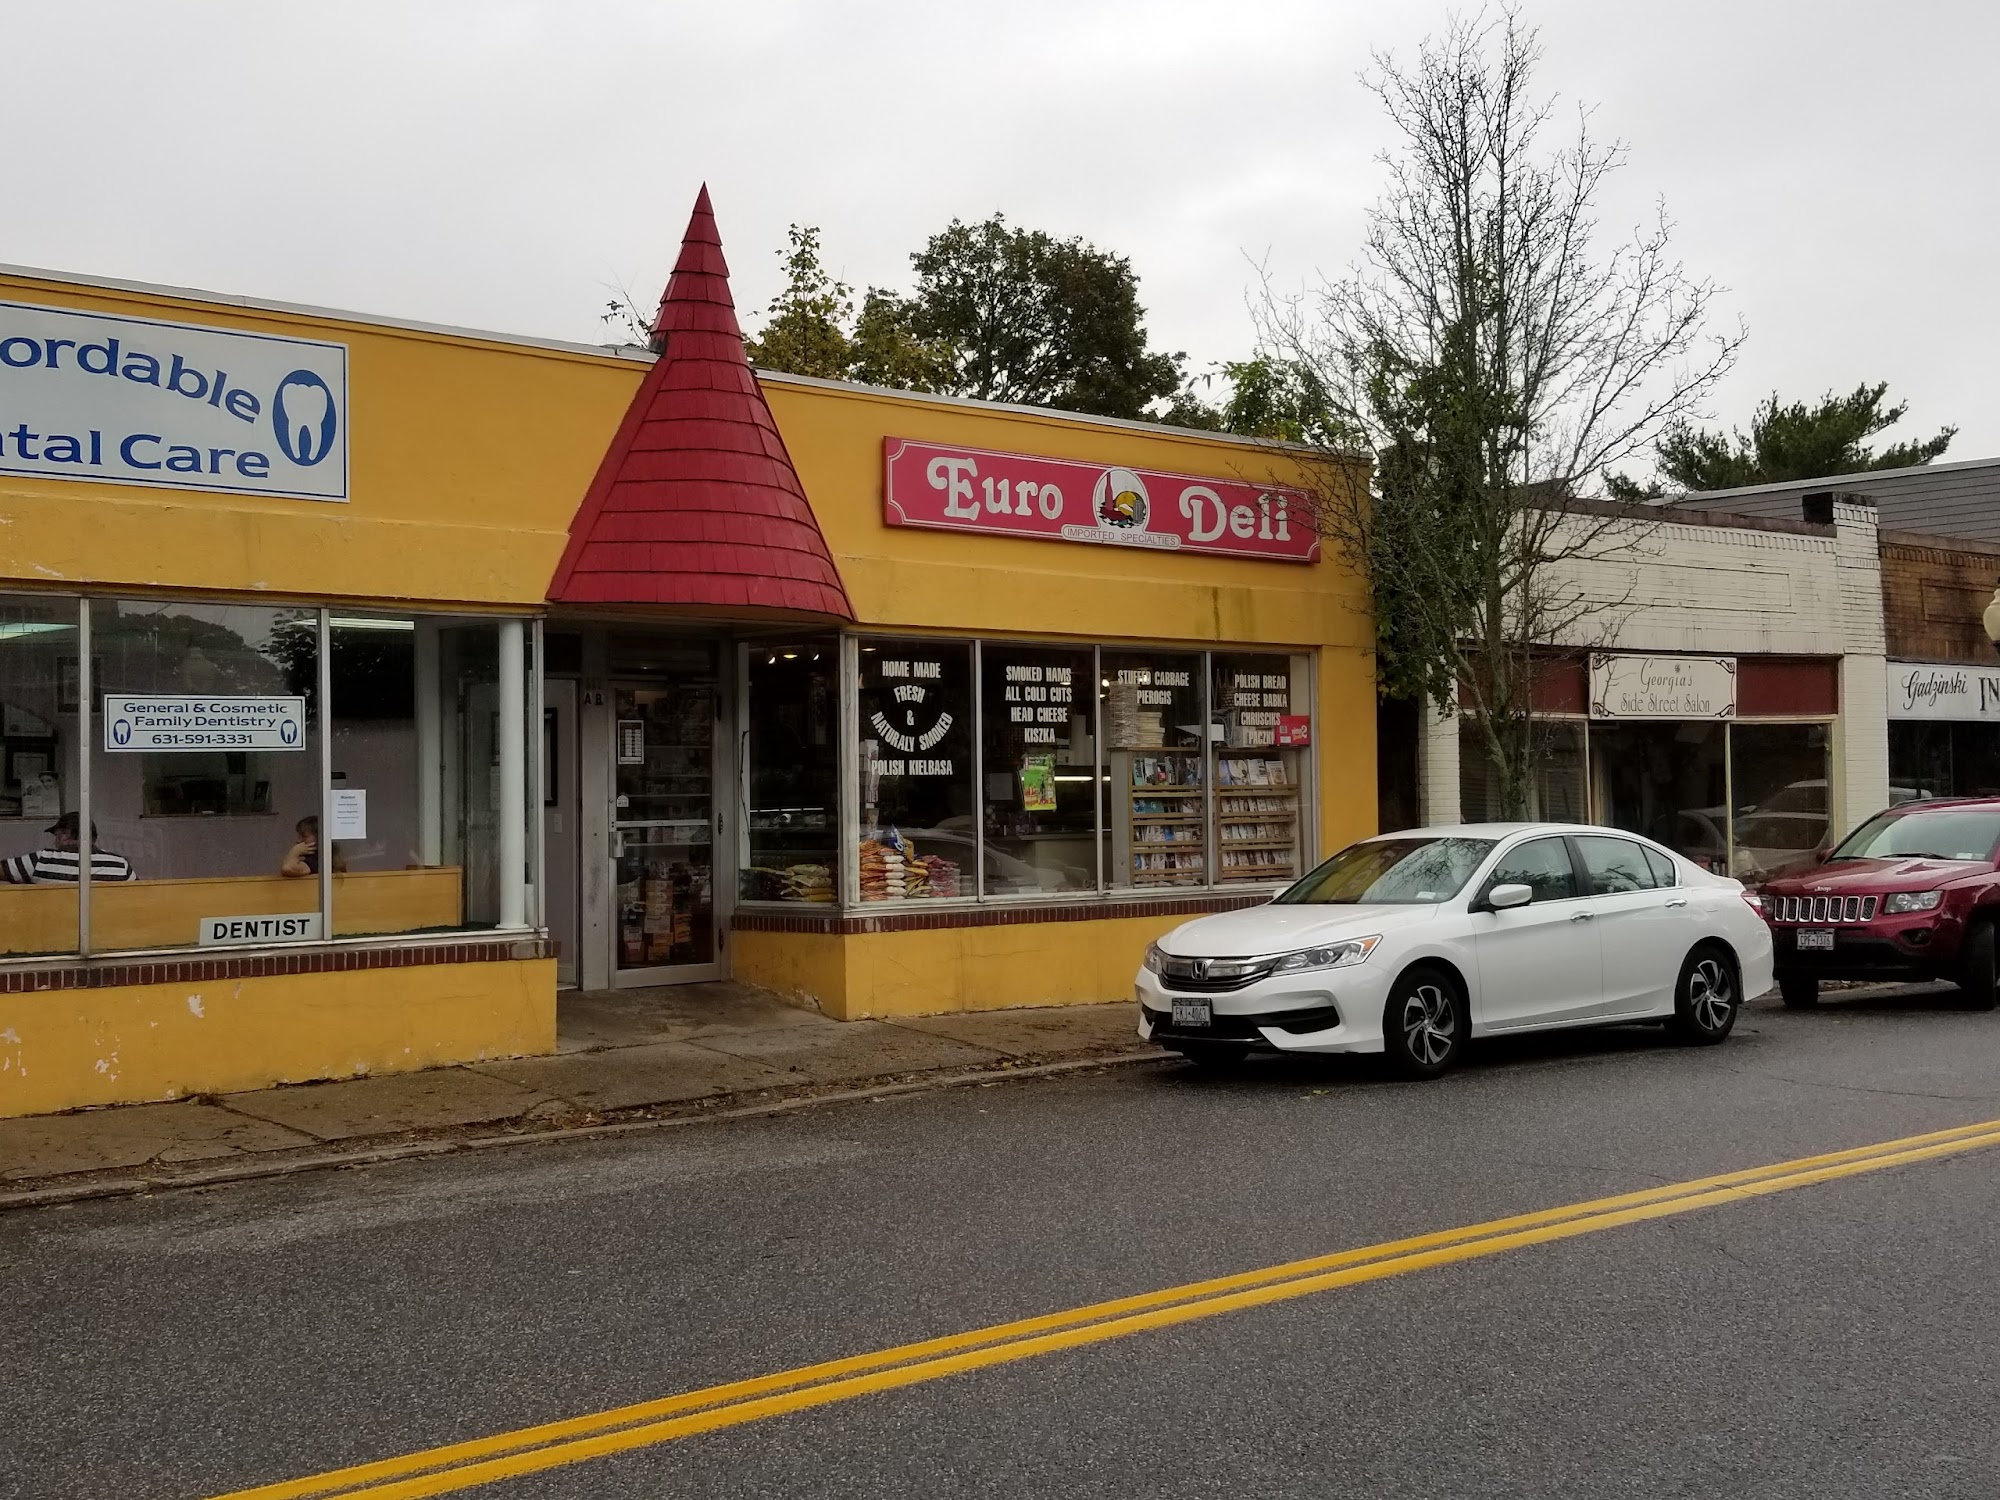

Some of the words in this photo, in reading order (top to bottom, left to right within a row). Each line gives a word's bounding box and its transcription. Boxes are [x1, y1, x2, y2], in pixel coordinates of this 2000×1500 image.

[0, 337, 261, 424] ordable
[0, 423, 103, 465] tal
[120, 434, 270, 478] Care
[926, 456, 1064, 521] Euro
[1178, 485, 1292, 542] Deli
[1067, 528, 1115, 540] IMPORTED
[1120, 533, 1176, 546] SPECIALTIES
[882, 661, 909, 677] HOME
[913, 661, 941, 678] MADE
[1005, 665, 1042, 682] SMOKED
[1045, 667, 1072, 683] HAMS
[1117, 669, 1152, 685] STUFFED
[1154, 671, 1189, 686] CABBAGE
[1640, 656, 1692, 694] Georgia's
[1234, 674, 1260, 689] POLISH
[1263, 675, 1286, 689] BREAD
[1901, 670, 1967, 710] Gadzinski
[893, 685, 926, 703] FRESH
[1005, 686, 1021, 701] ALL
[1024, 686, 1046, 702] COLD
[1050, 687, 1072, 703] CUTS
[1136, 690, 1172, 705] PIEROGIS
[1233, 692, 1260, 707] CHEESE
[1263, 693, 1287, 707] BABKA
[1620, 693, 1643, 712] Side
[1647, 693, 1679, 712] Street
[1684, 693, 1710, 712] Salon
[123, 702, 189, 713] General
[193, 703, 206, 713] &
[209, 703, 287, 714] Cosmetic
[1011, 707, 1033, 722] HEAD
[1036, 707, 1068, 722] CHEESE
[134, 716, 192, 728] Family
[195, 716, 277, 728] Dentistry
[906, 709, 915, 726] &
[1241, 711, 1281, 726] CHRUSCIKS
[151, 734, 254, 745] 631-591-3331
[870, 711, 915, 752] NATURALY
[919, 712, 953, 750] SMOKED
[1024, 727, 1056, 743] KISZKA
[871, 760, 905, 775] POLISH
[909, 760, 953, 775] KIELBASA
[213, 918, 311, 940] DENTIST
